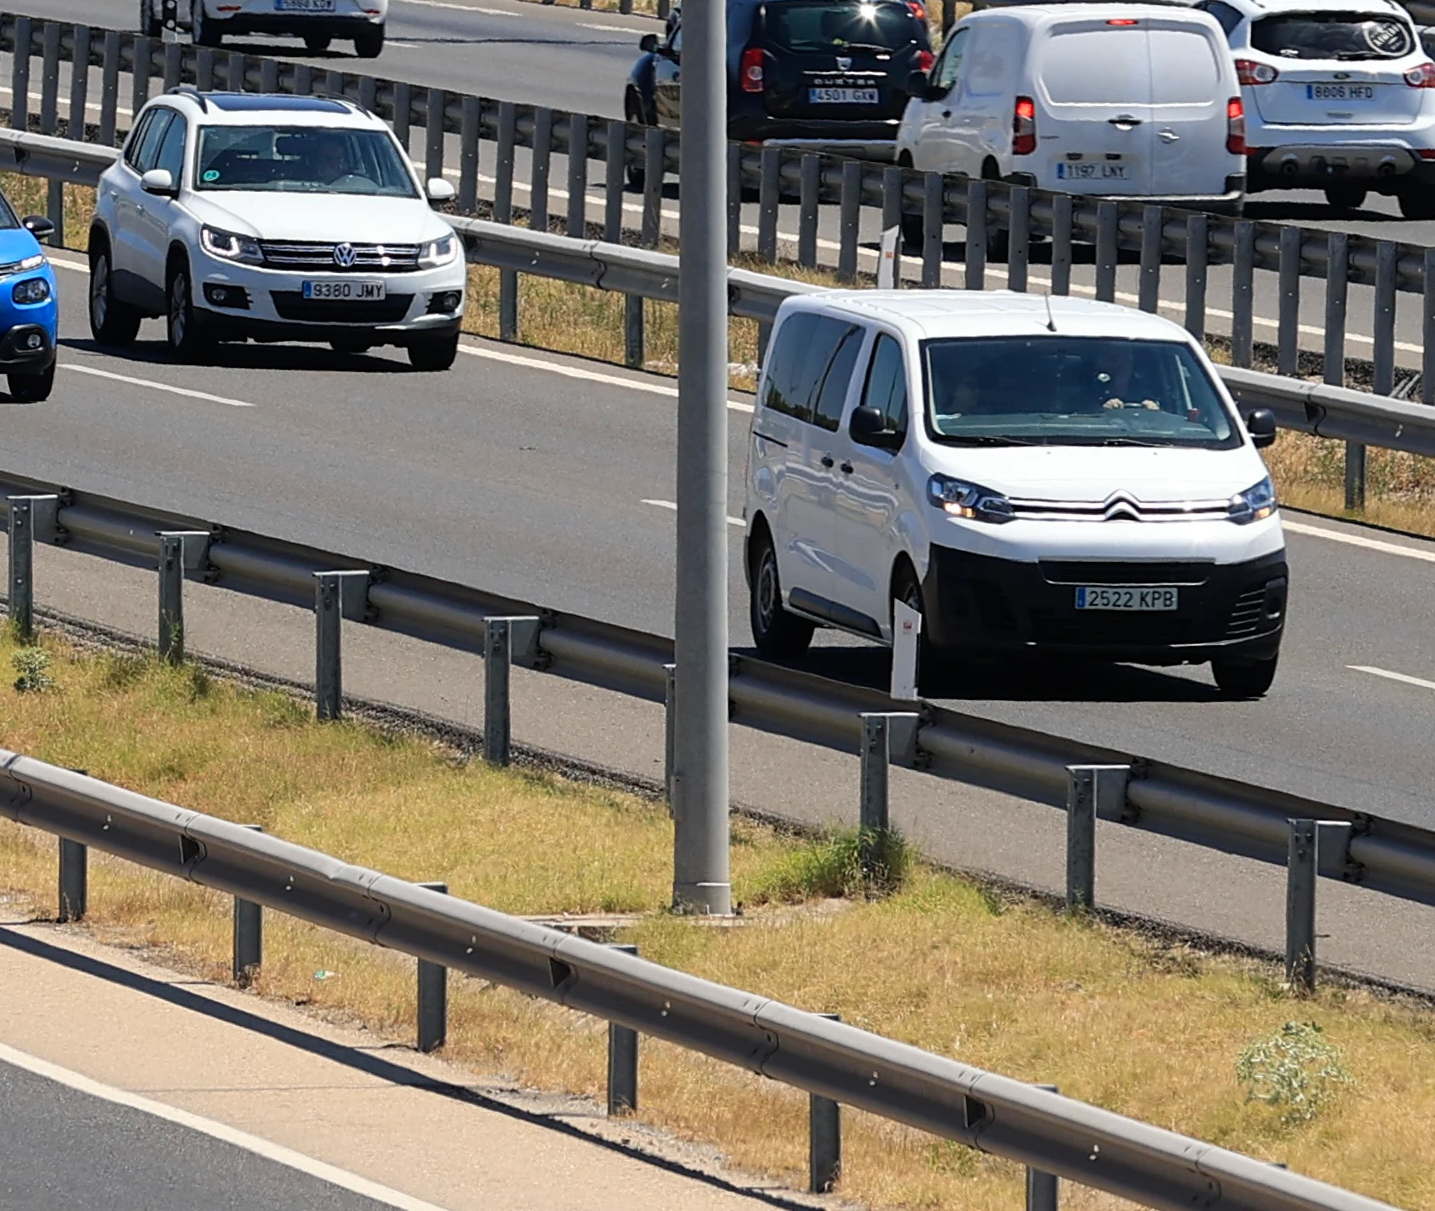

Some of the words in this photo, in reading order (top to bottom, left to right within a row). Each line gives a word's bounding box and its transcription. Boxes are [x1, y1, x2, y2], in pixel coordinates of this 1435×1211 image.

[313, 283, 352, 298] 9380
[355, 284, 383, 298] JMY
[1088, 590, 1134, 608] 2522
[1139, 591, 1174, 608] KPB
